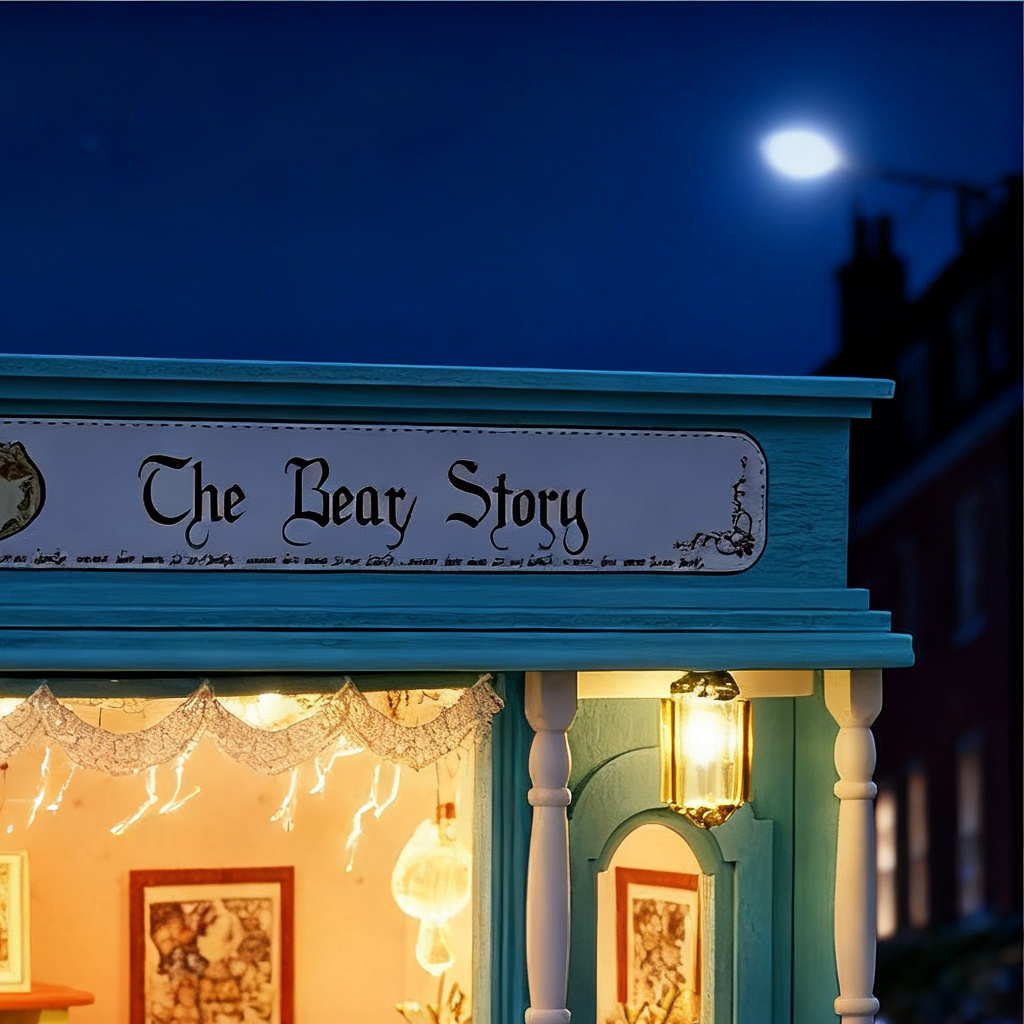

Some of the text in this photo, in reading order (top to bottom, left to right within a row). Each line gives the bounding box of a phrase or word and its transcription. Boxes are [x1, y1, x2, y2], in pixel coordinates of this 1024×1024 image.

[137, 454, 590, 556] The Bear Story
